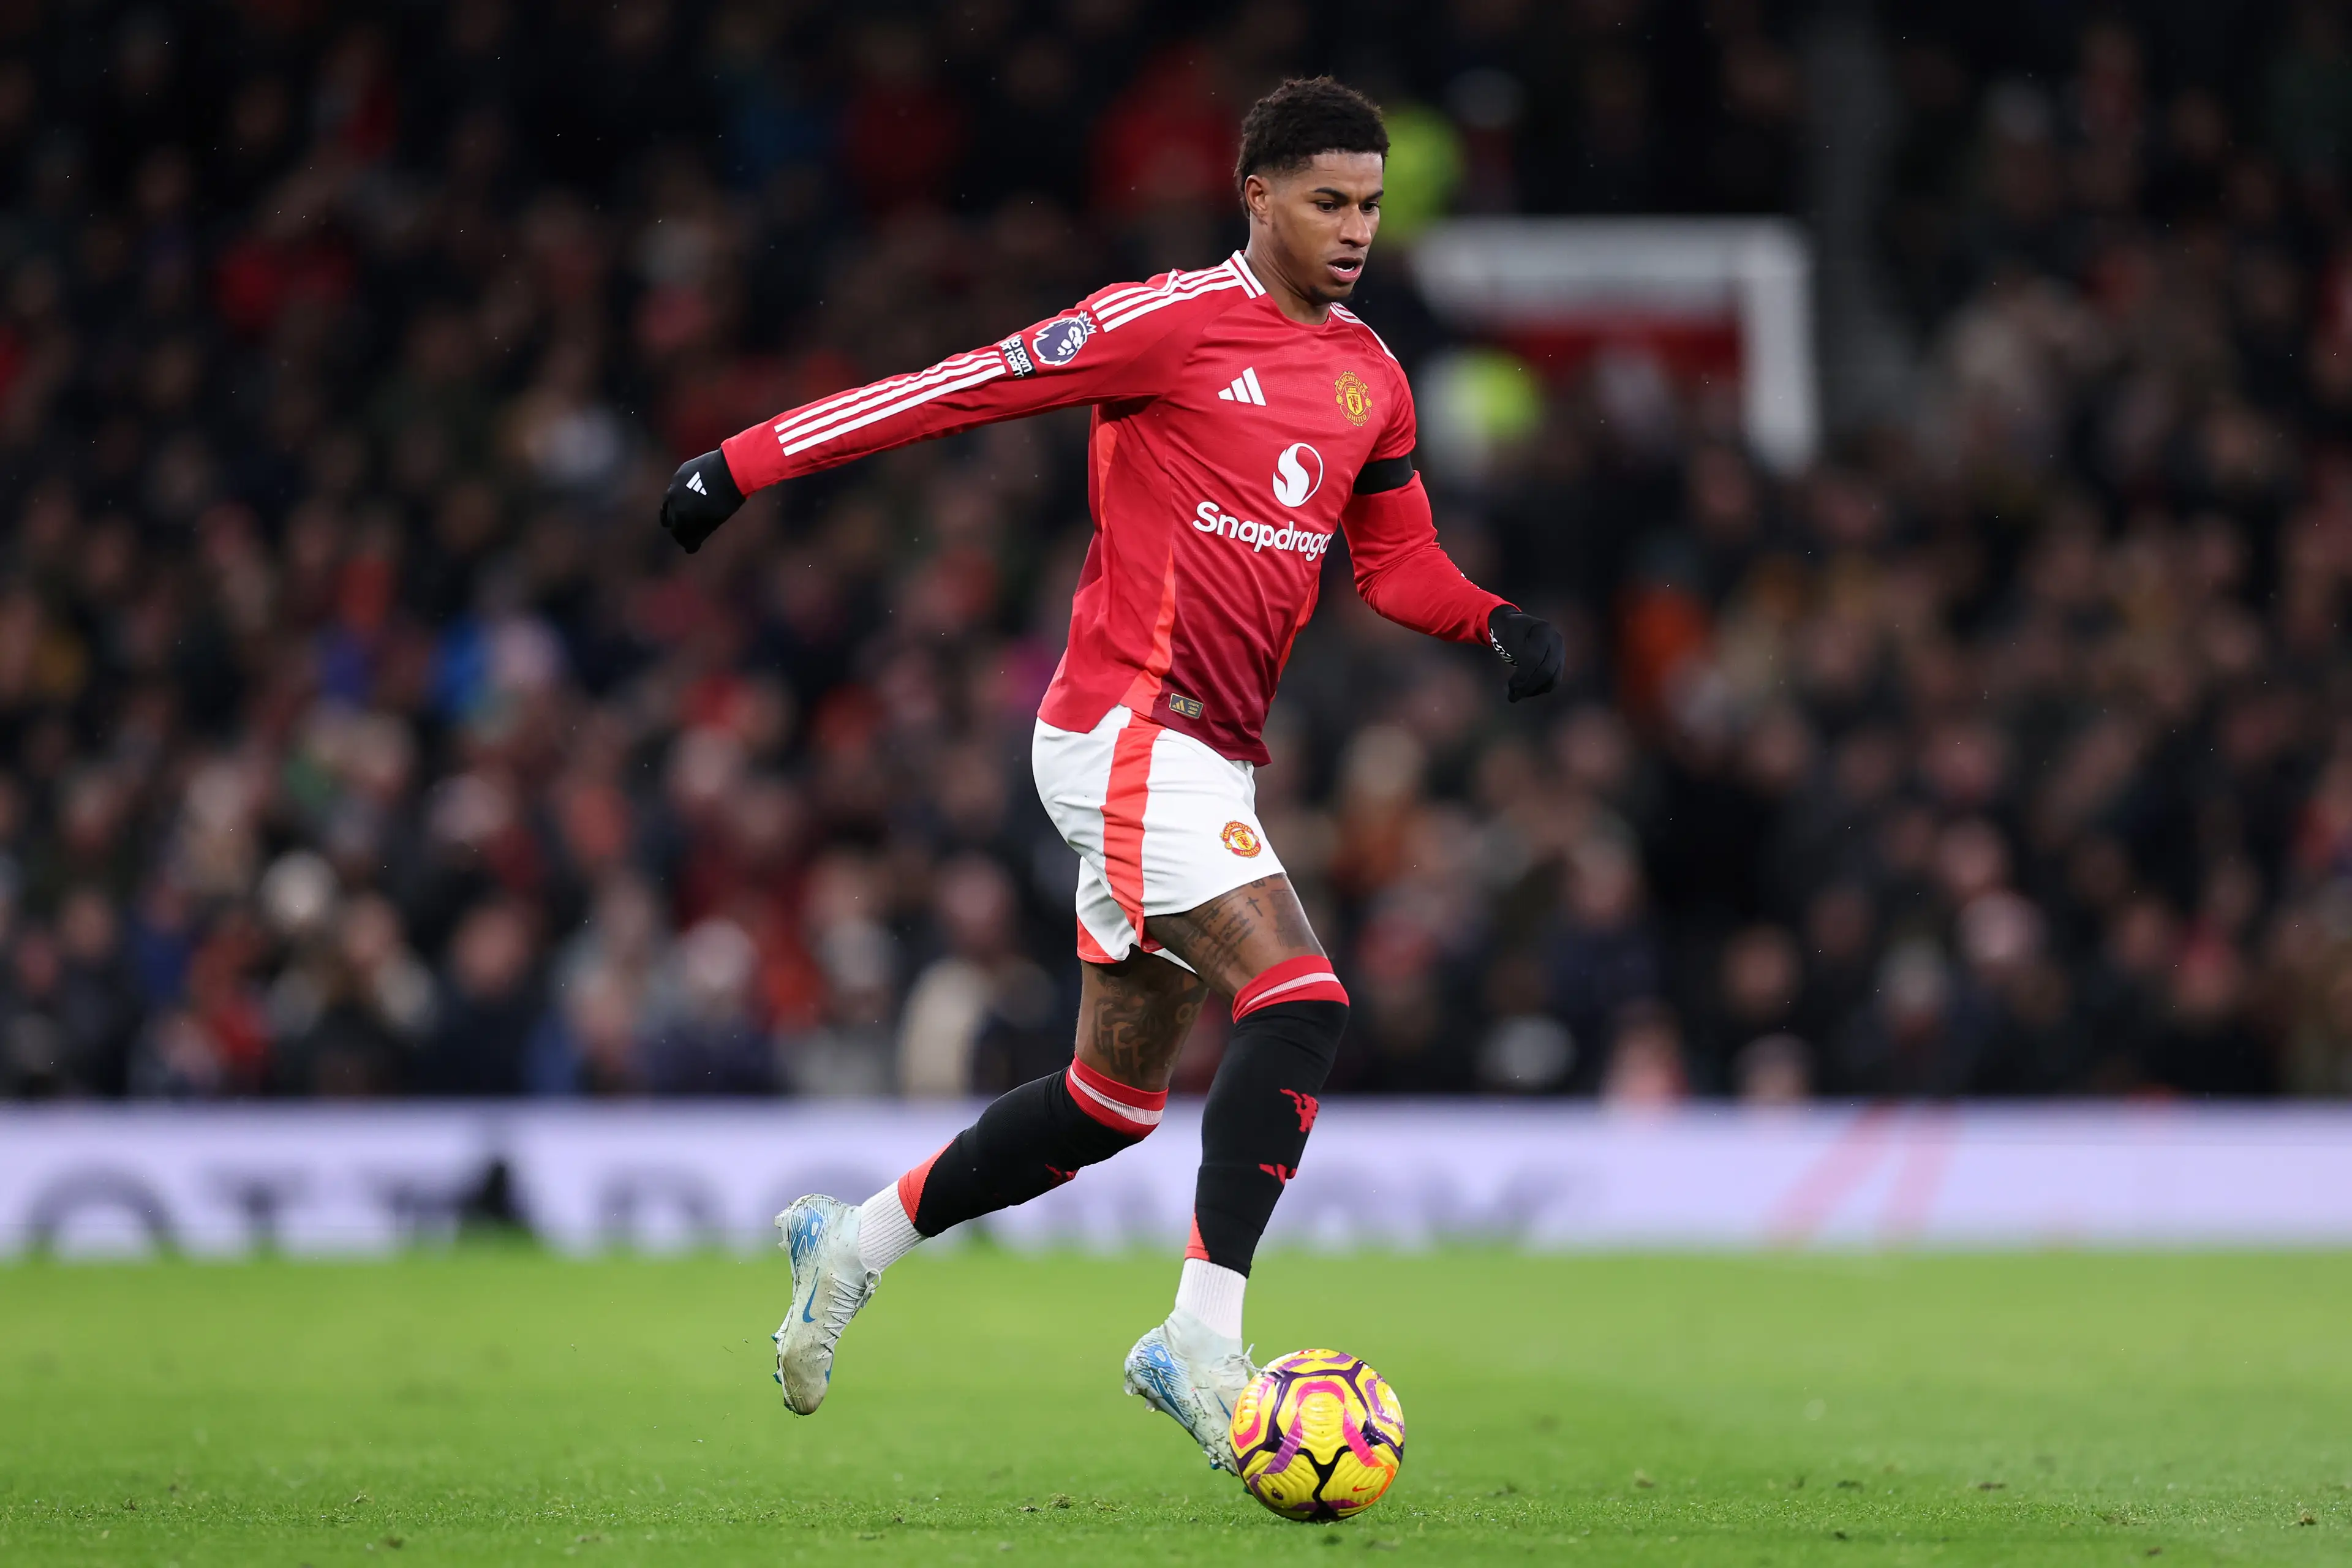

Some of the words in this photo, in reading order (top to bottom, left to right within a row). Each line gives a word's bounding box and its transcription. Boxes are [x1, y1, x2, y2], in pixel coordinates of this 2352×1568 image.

[1014, 347, 1033, 372] room
[1338, 375, 1366, 394] MANCHESTER
[1347, 412, 1367, 423] UNITED
[1193, 501, 1333, 562] Snapdrago
[1224, 823, 1251, 839] MANCHESTER
